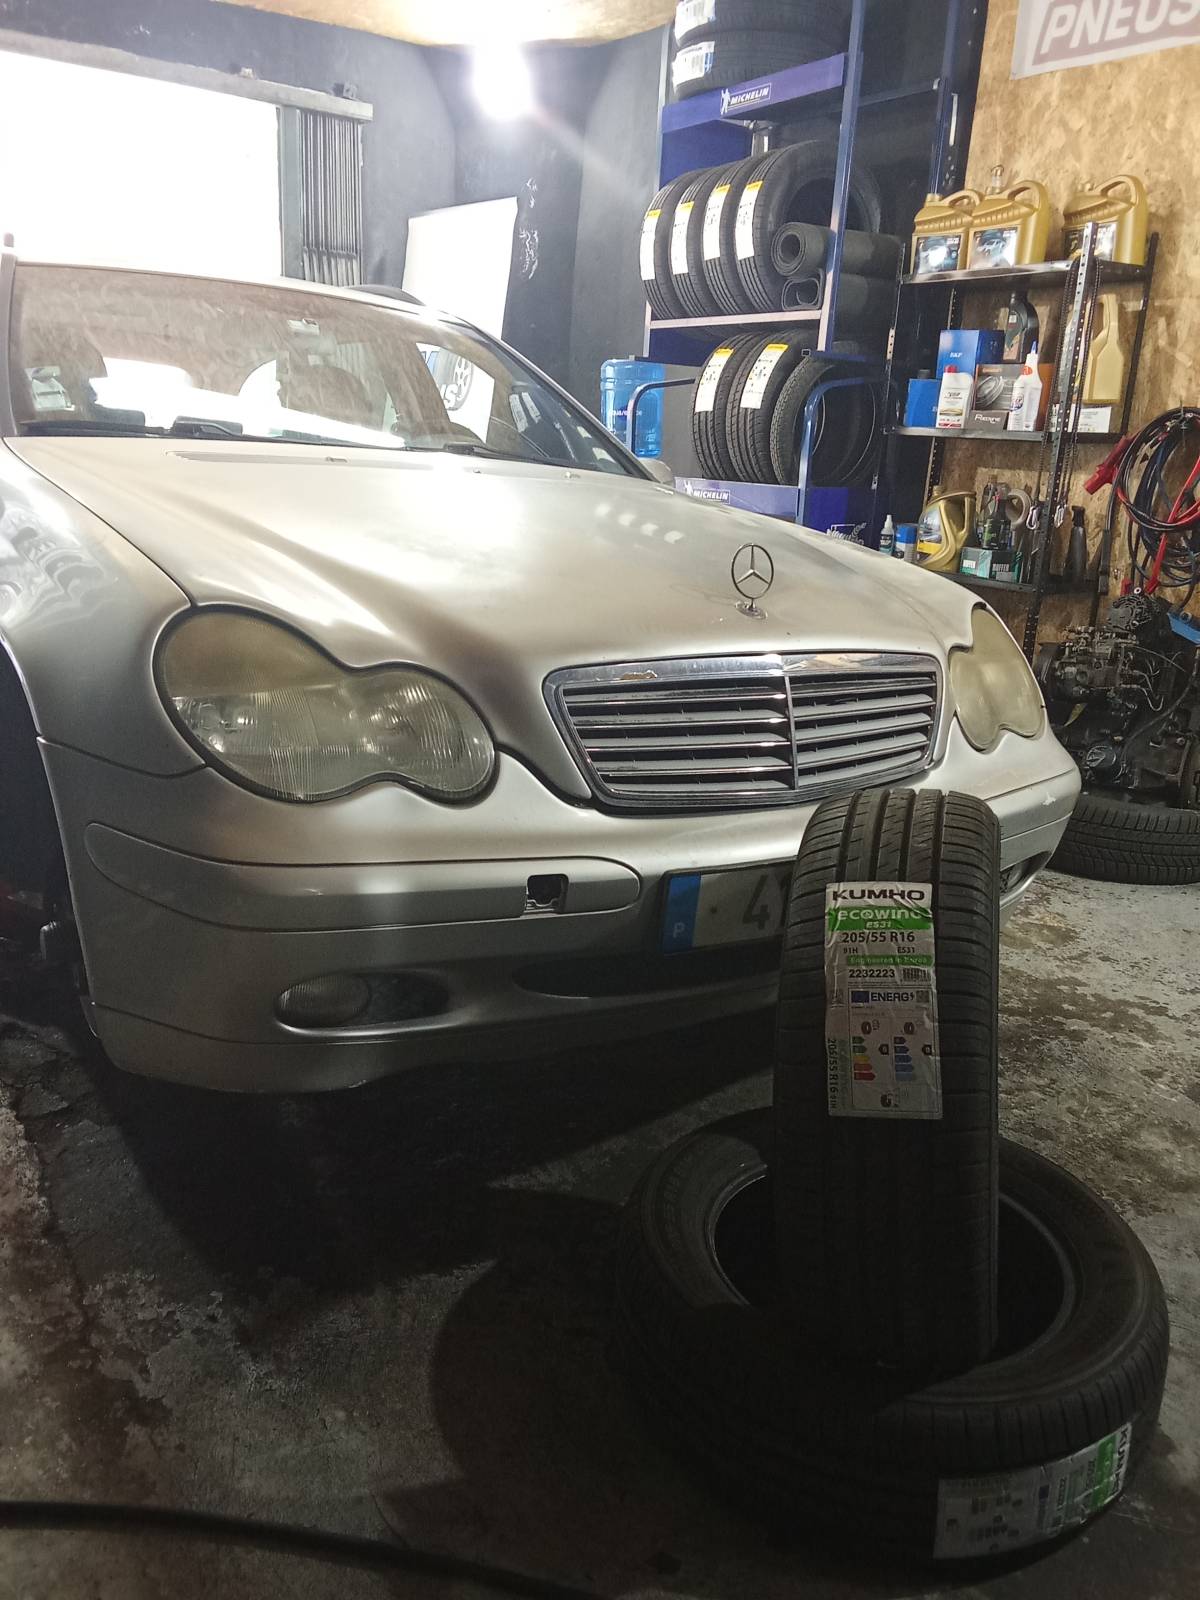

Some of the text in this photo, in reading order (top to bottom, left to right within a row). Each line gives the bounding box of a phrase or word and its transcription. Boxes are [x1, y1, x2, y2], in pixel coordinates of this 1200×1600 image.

[730, 87, 769, 104] MICHELIN
[693, 489, 729, 500] MICHELIN
[832, 889, 925, 901] KUMHO
[673, 922, 685, 938] P
[842, 931, 916, 944] 205/55 R16
[848, 968, 896, 978] 2232223
